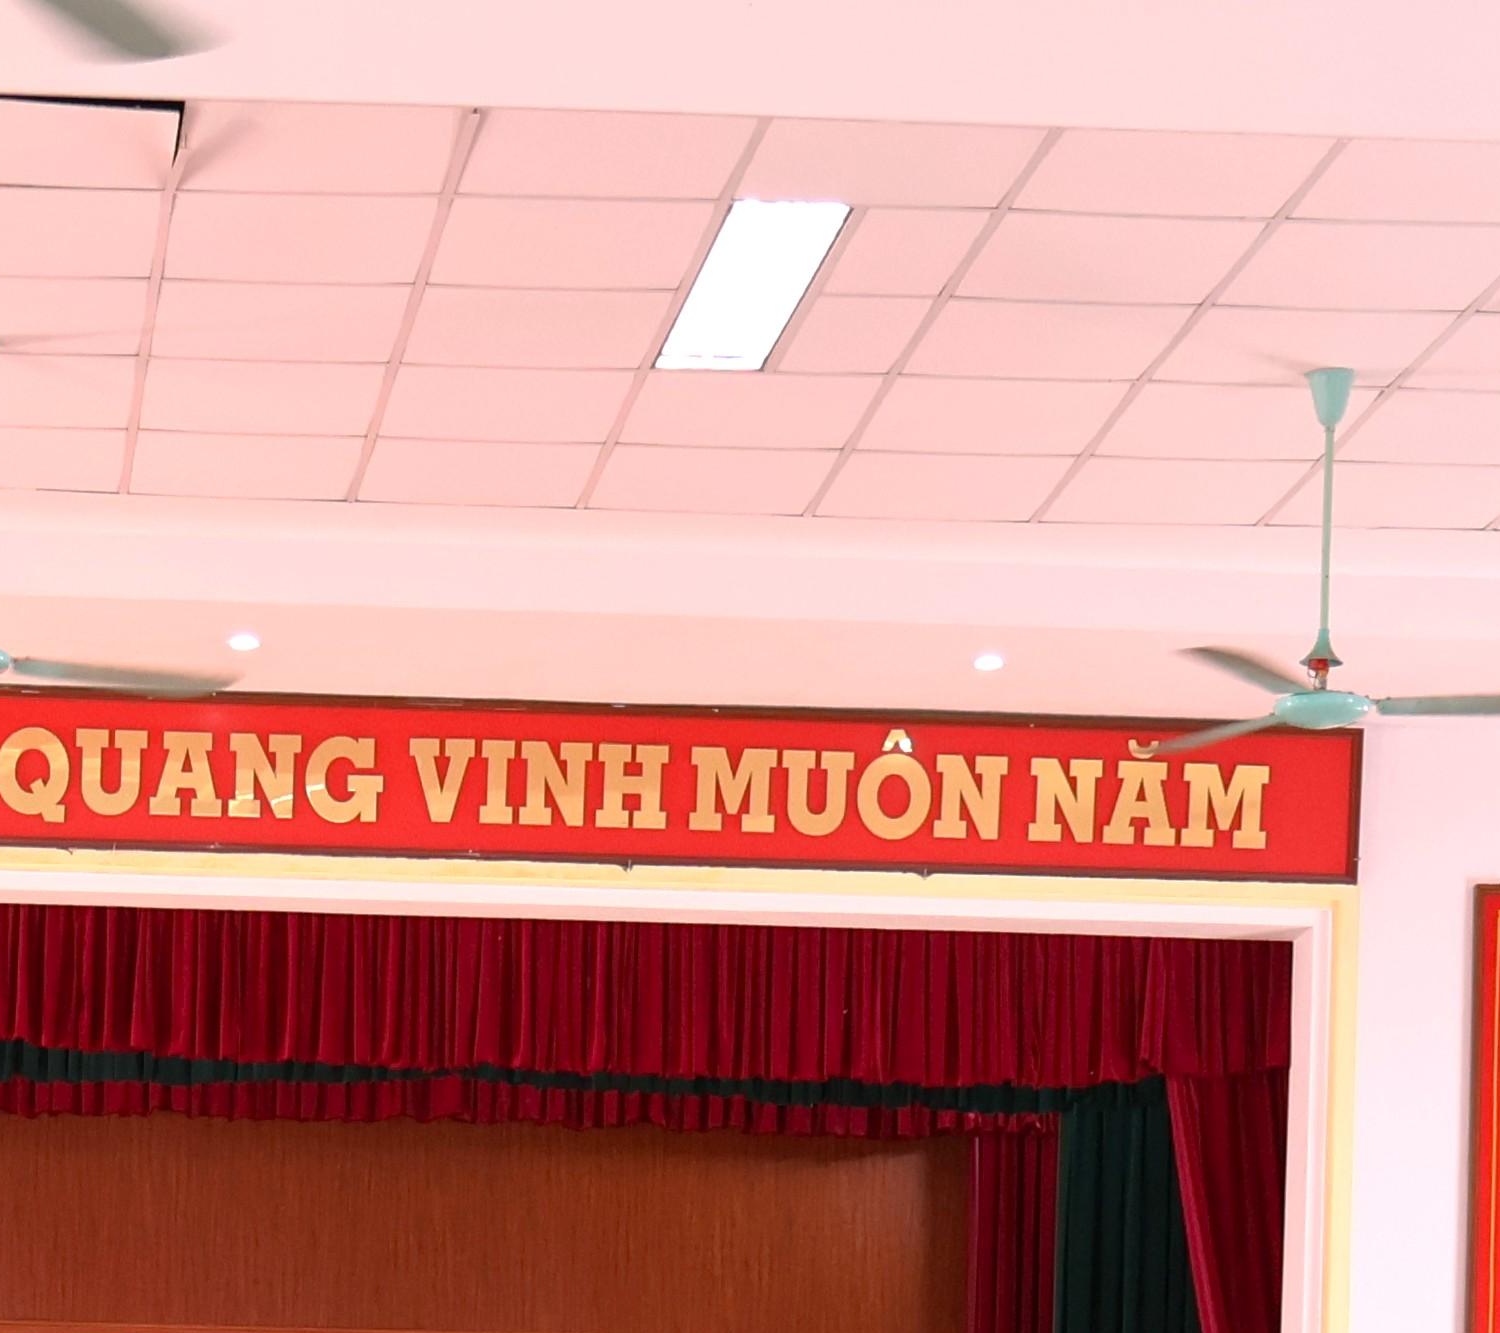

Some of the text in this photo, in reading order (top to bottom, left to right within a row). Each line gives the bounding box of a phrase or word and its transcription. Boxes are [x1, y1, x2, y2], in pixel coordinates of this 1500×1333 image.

[410, 739, 669, 829] VINH
[689, 729, 1008, 839] MUÔN
[1028, 740, 1269, 849] NĂM
